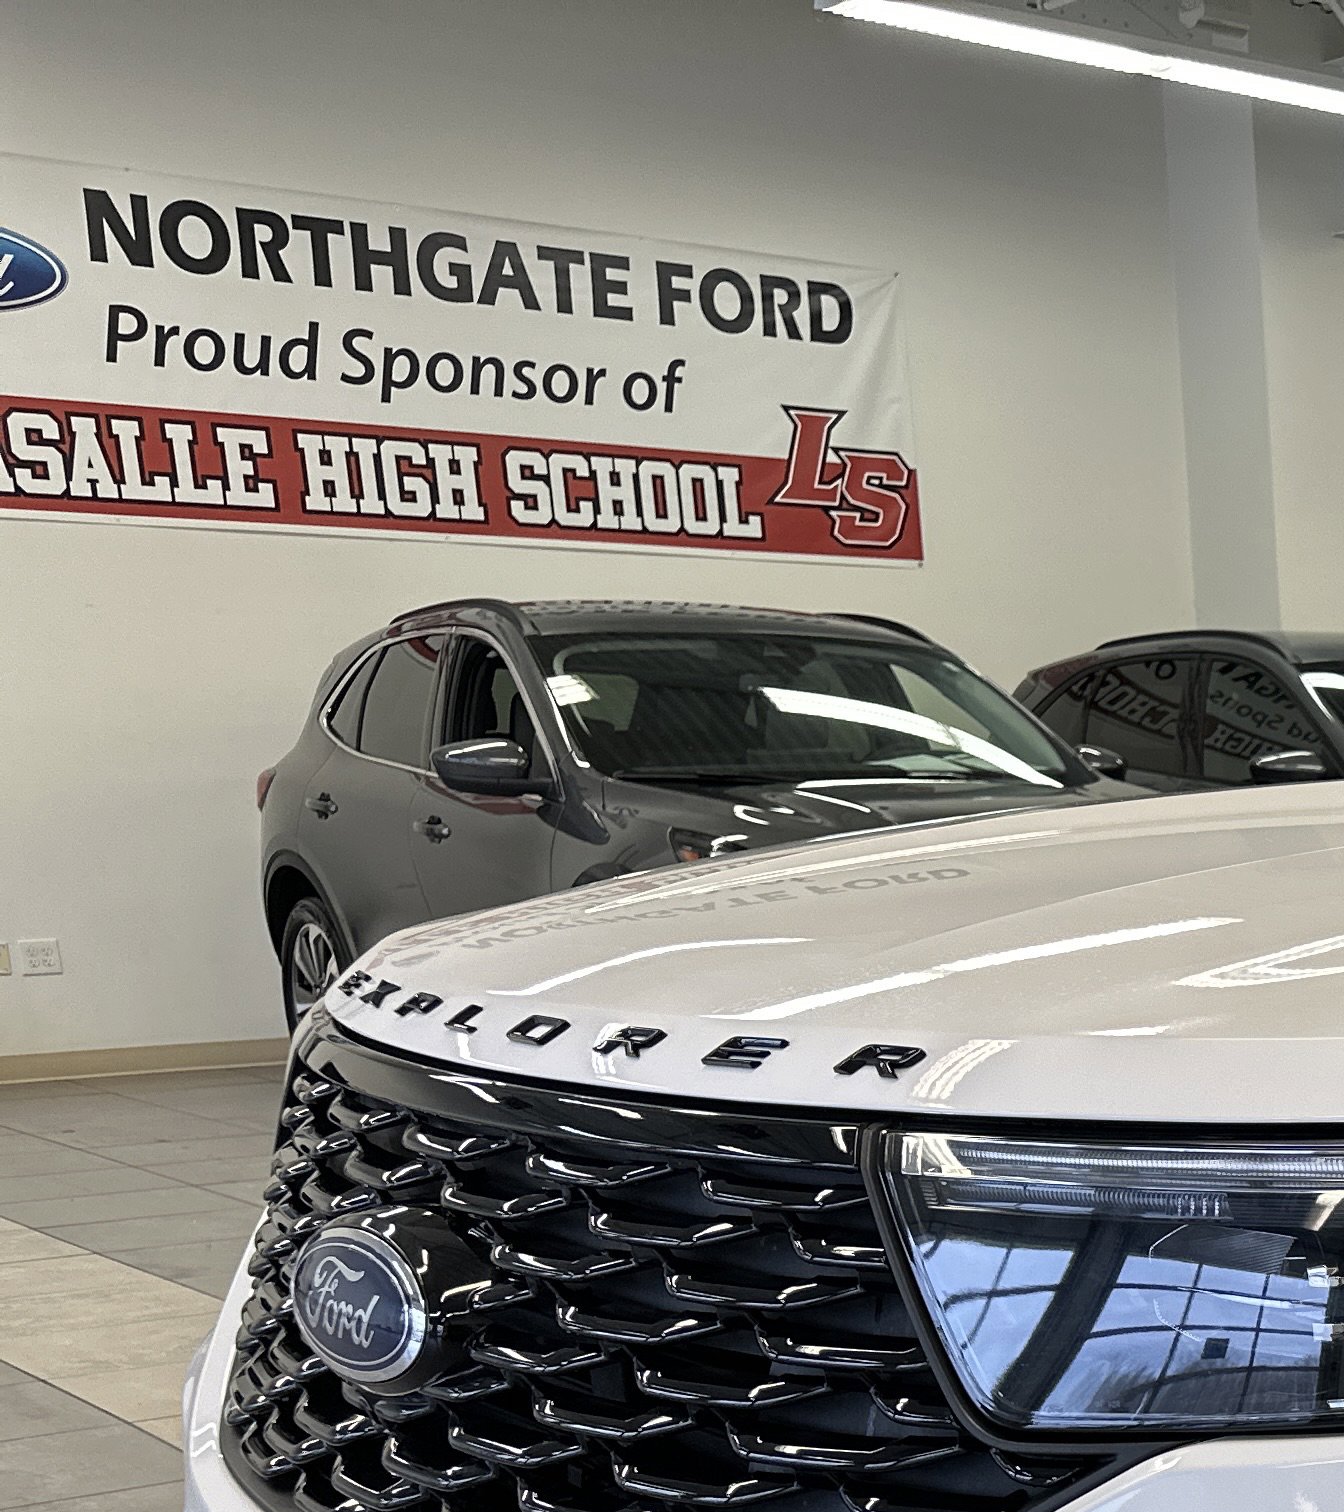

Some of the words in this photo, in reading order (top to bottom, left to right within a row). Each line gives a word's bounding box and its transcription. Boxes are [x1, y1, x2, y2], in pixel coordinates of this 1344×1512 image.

[82, 187, 632, 321] NORTHGATE
[655, 261, 855, 345] FORD
[104, 303, 319, 381] Proud
[340, 328, 607, 405] Sponsor
[622, 360, 686, 414] of
[296, 430, 489, 523] HIGH
[504, 446, 764, 540] SCHOOL
[337, 969, 928, 1080] EXPLORER
[306, 1255, 380, 1349] Ford
